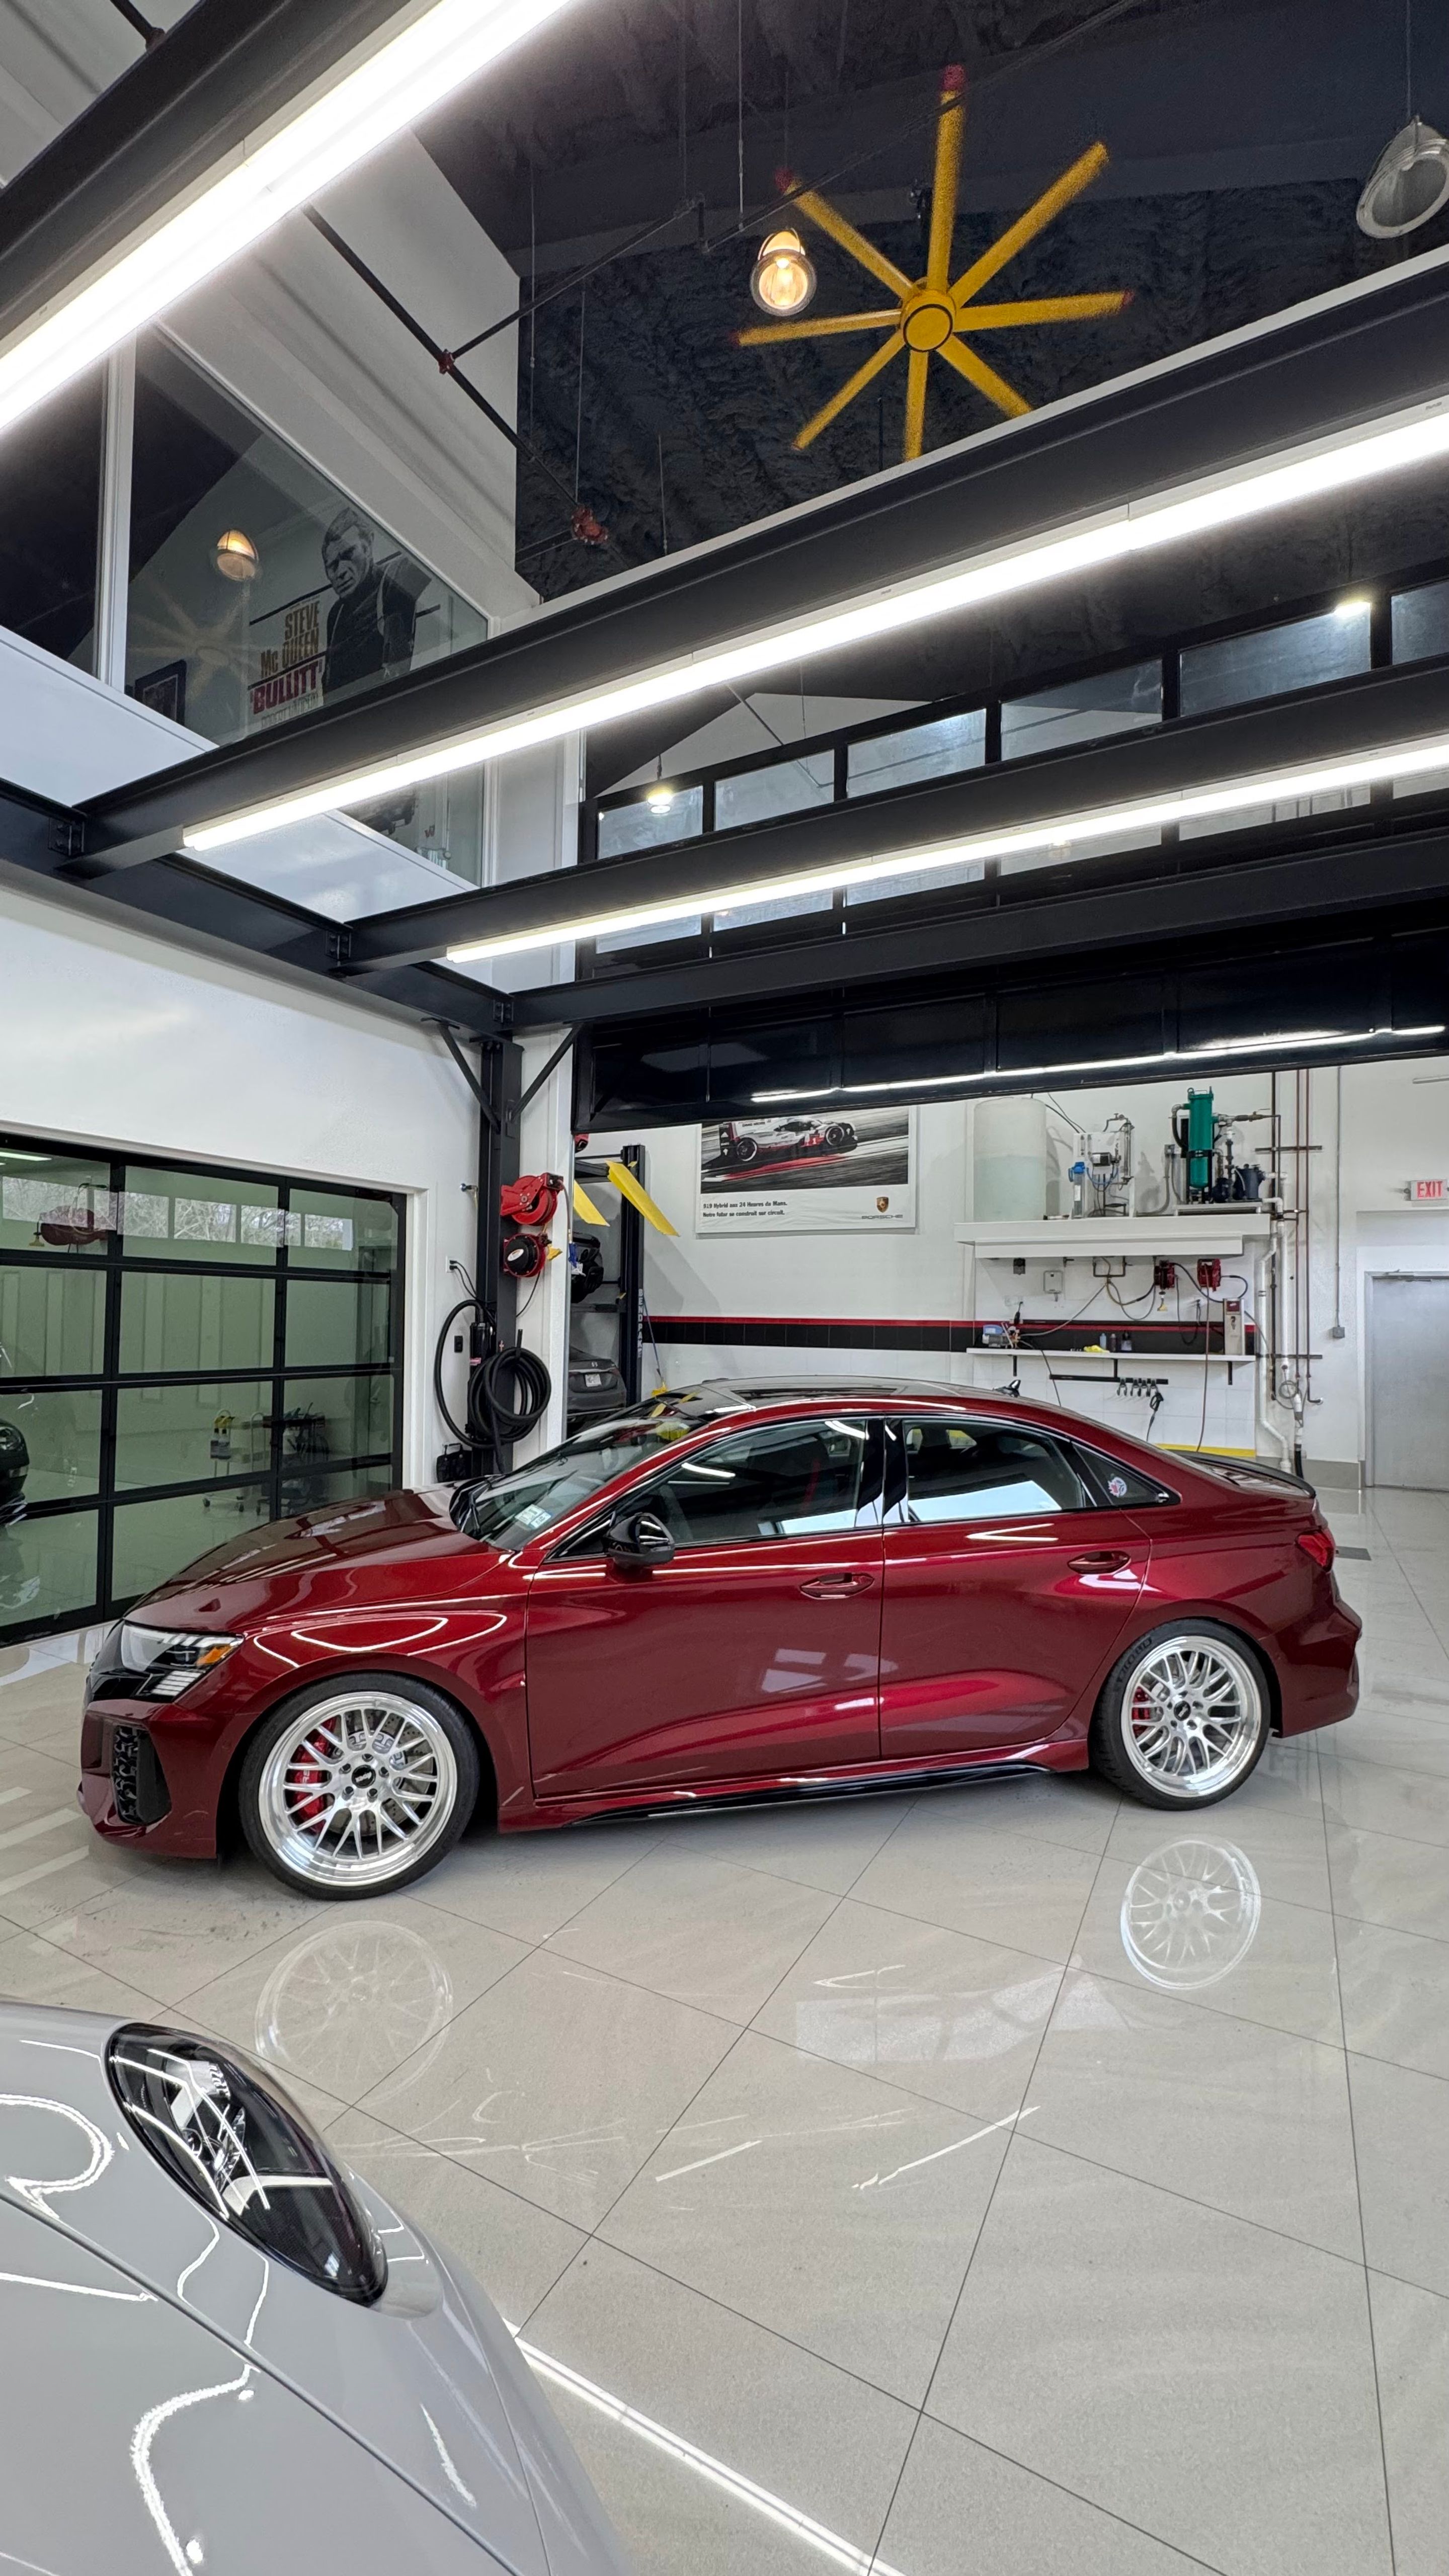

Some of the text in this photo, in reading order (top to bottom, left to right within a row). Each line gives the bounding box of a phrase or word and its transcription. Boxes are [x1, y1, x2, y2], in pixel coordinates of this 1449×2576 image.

[285, 601, 320, 640] STEVE
[282, 628, 319, 668] QUEEN
[1417, 1181, 1443, 1198] EXIT
